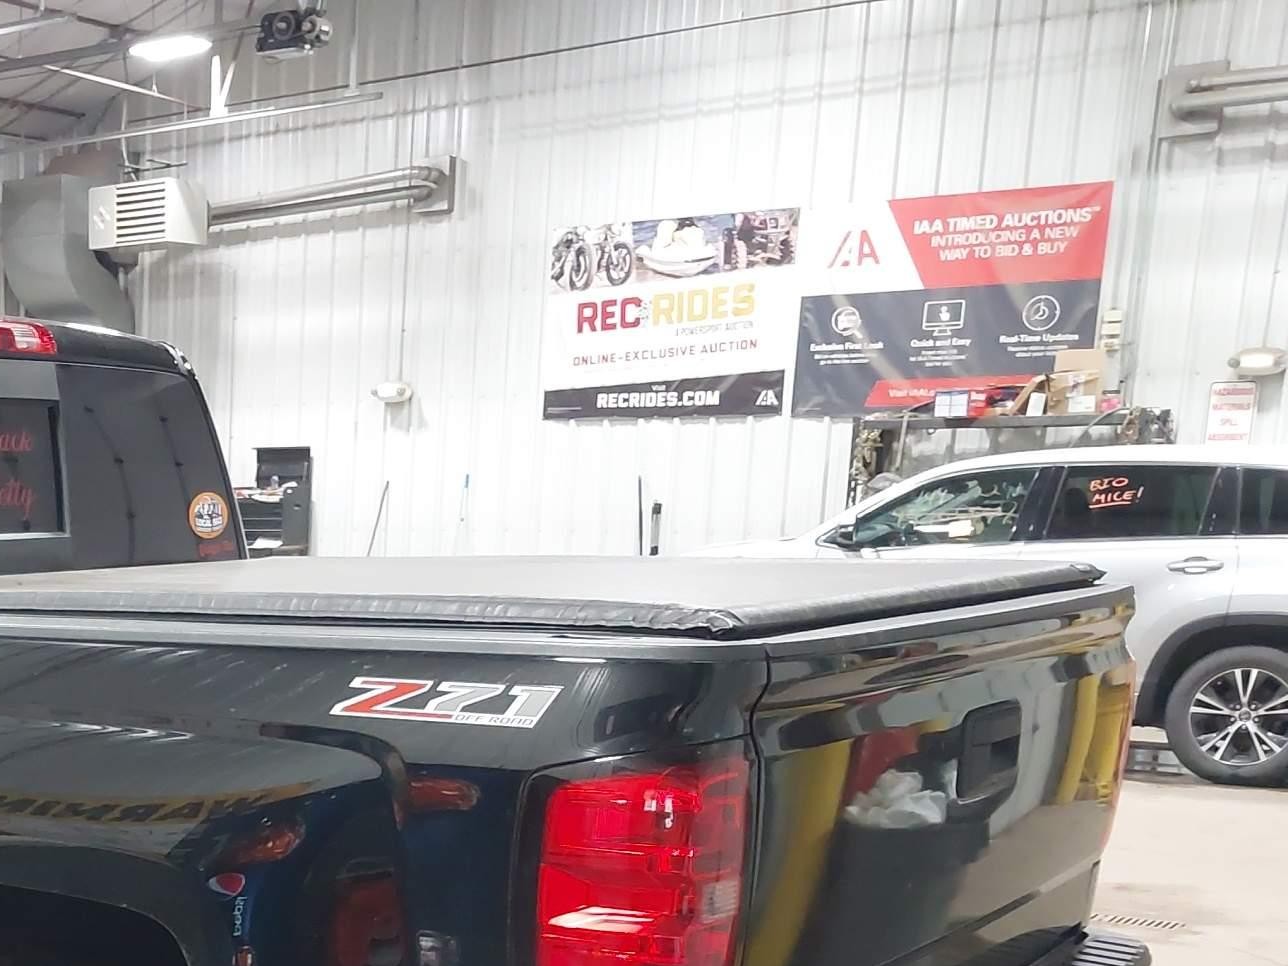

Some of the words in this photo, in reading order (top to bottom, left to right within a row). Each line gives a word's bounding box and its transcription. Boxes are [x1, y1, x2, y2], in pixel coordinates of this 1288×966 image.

[913, 219, 944, 235] IAA
[948, 214, 998, 232] TIMED
[930, 229, 1026, 248] INTRODUCING
[1029, 228, 1041, 241] A
[1044, 225, 1080, 240] NEW
[939, 247, 970, 261] WAY
[973, 245, 992, 259] TO
[995, 243, 1019, 257] BID
[1021, 243, 1033, 256] &
[1037, 240, 1068, 254] BUY
[652, 283, 756, 327] RIDES
[572, 345, 695, 367] ONLINE-EXCLUSIVE
[700, 338, 758, 354] AUCTION
[596, 390, 720, 408] RECRIDES.COM
[1088, 476, 1129, 491] BIO
[1091, 486, 1145, 504] MICE!
[329, 676, 565, 722] Z71
[453, 712, 482, 722] OFF
[487, 715, 535, 727] ROAD
